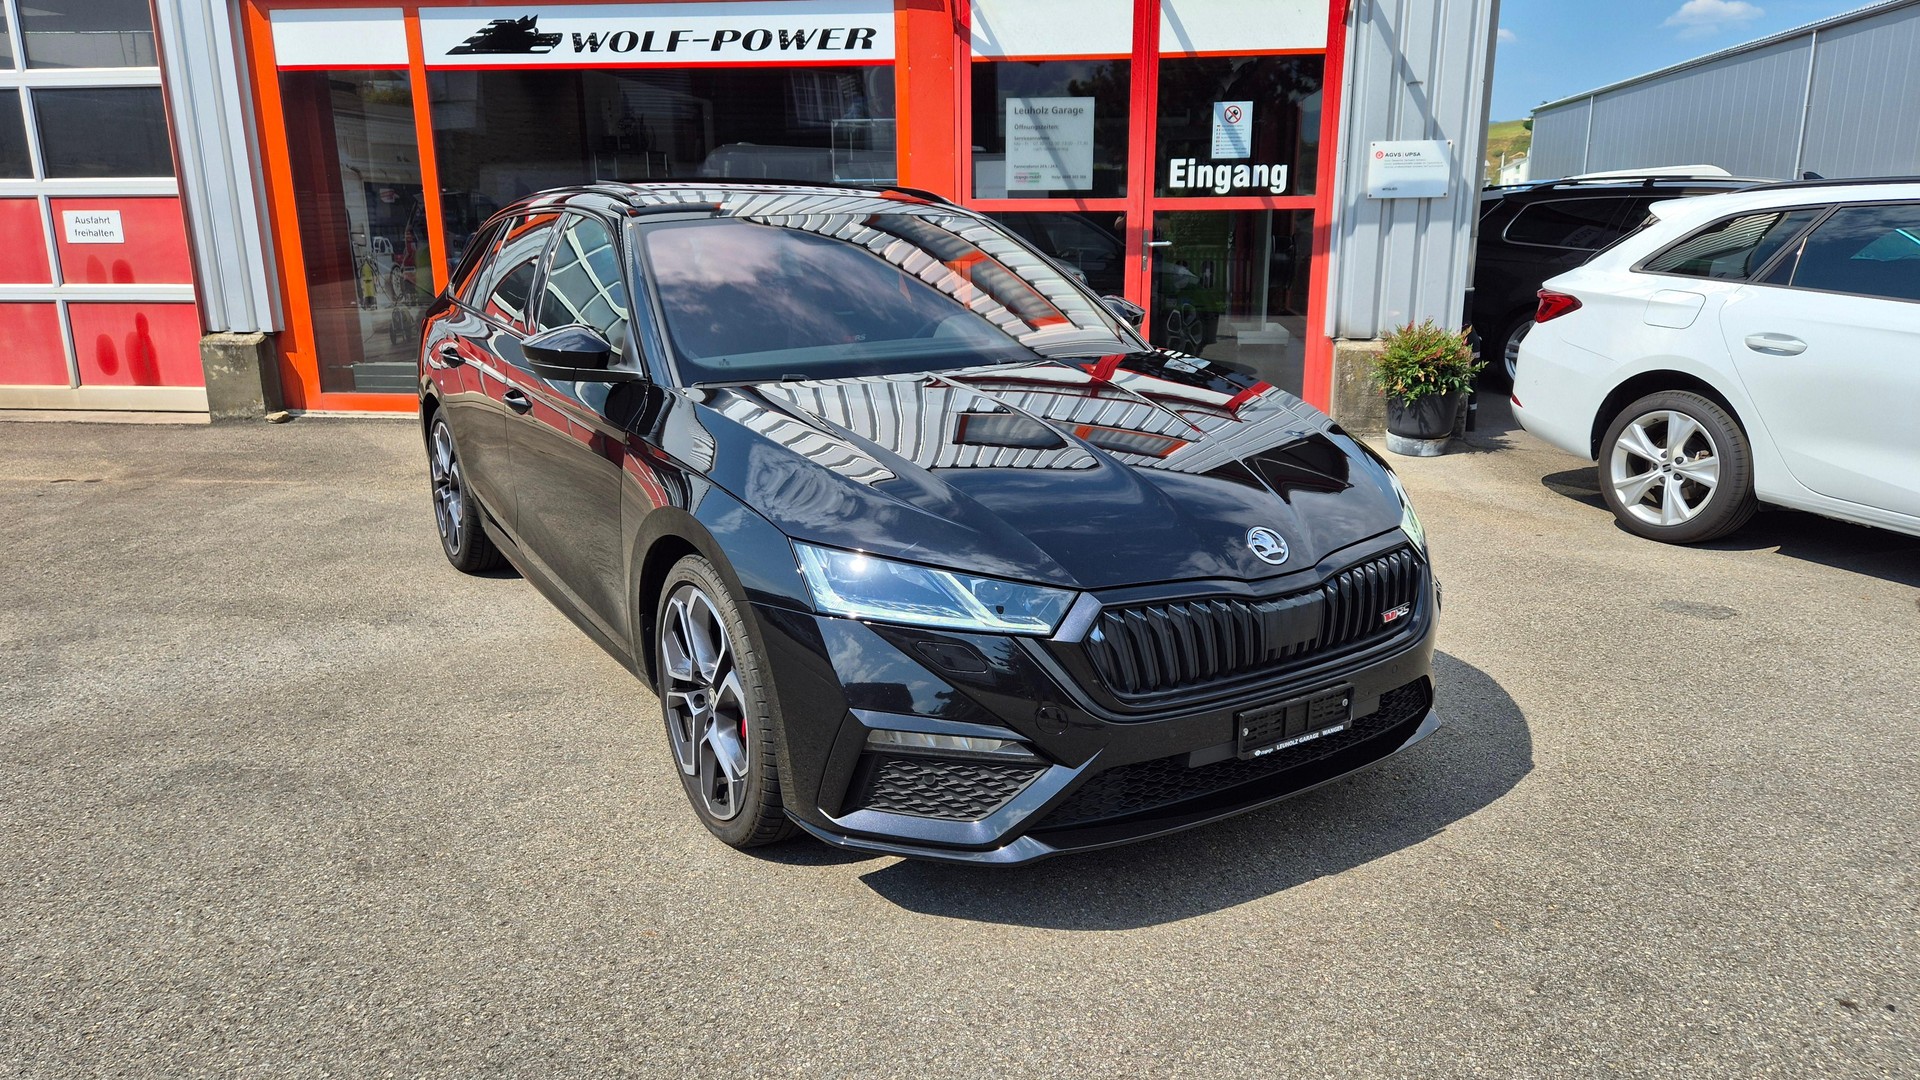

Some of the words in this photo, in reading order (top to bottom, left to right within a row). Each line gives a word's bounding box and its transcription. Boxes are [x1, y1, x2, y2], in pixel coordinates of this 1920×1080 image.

[571, 27, 877, 53] WOLF-POWER
[1014, 106, 1049, 115] Leuholz
[1051, 106, 1084, 116] Garage
[1169, 158, 1288, 194] Eingang
[75, 216, 111, 224] Ausfahrt
[74, 229, 115, 237] freihalten
[1276, 739, 1299, 750] LEUHOLZ
[1298, 731, 1320, 743] GARAGE
[1322, 724, 1344, 736] WANGEN
